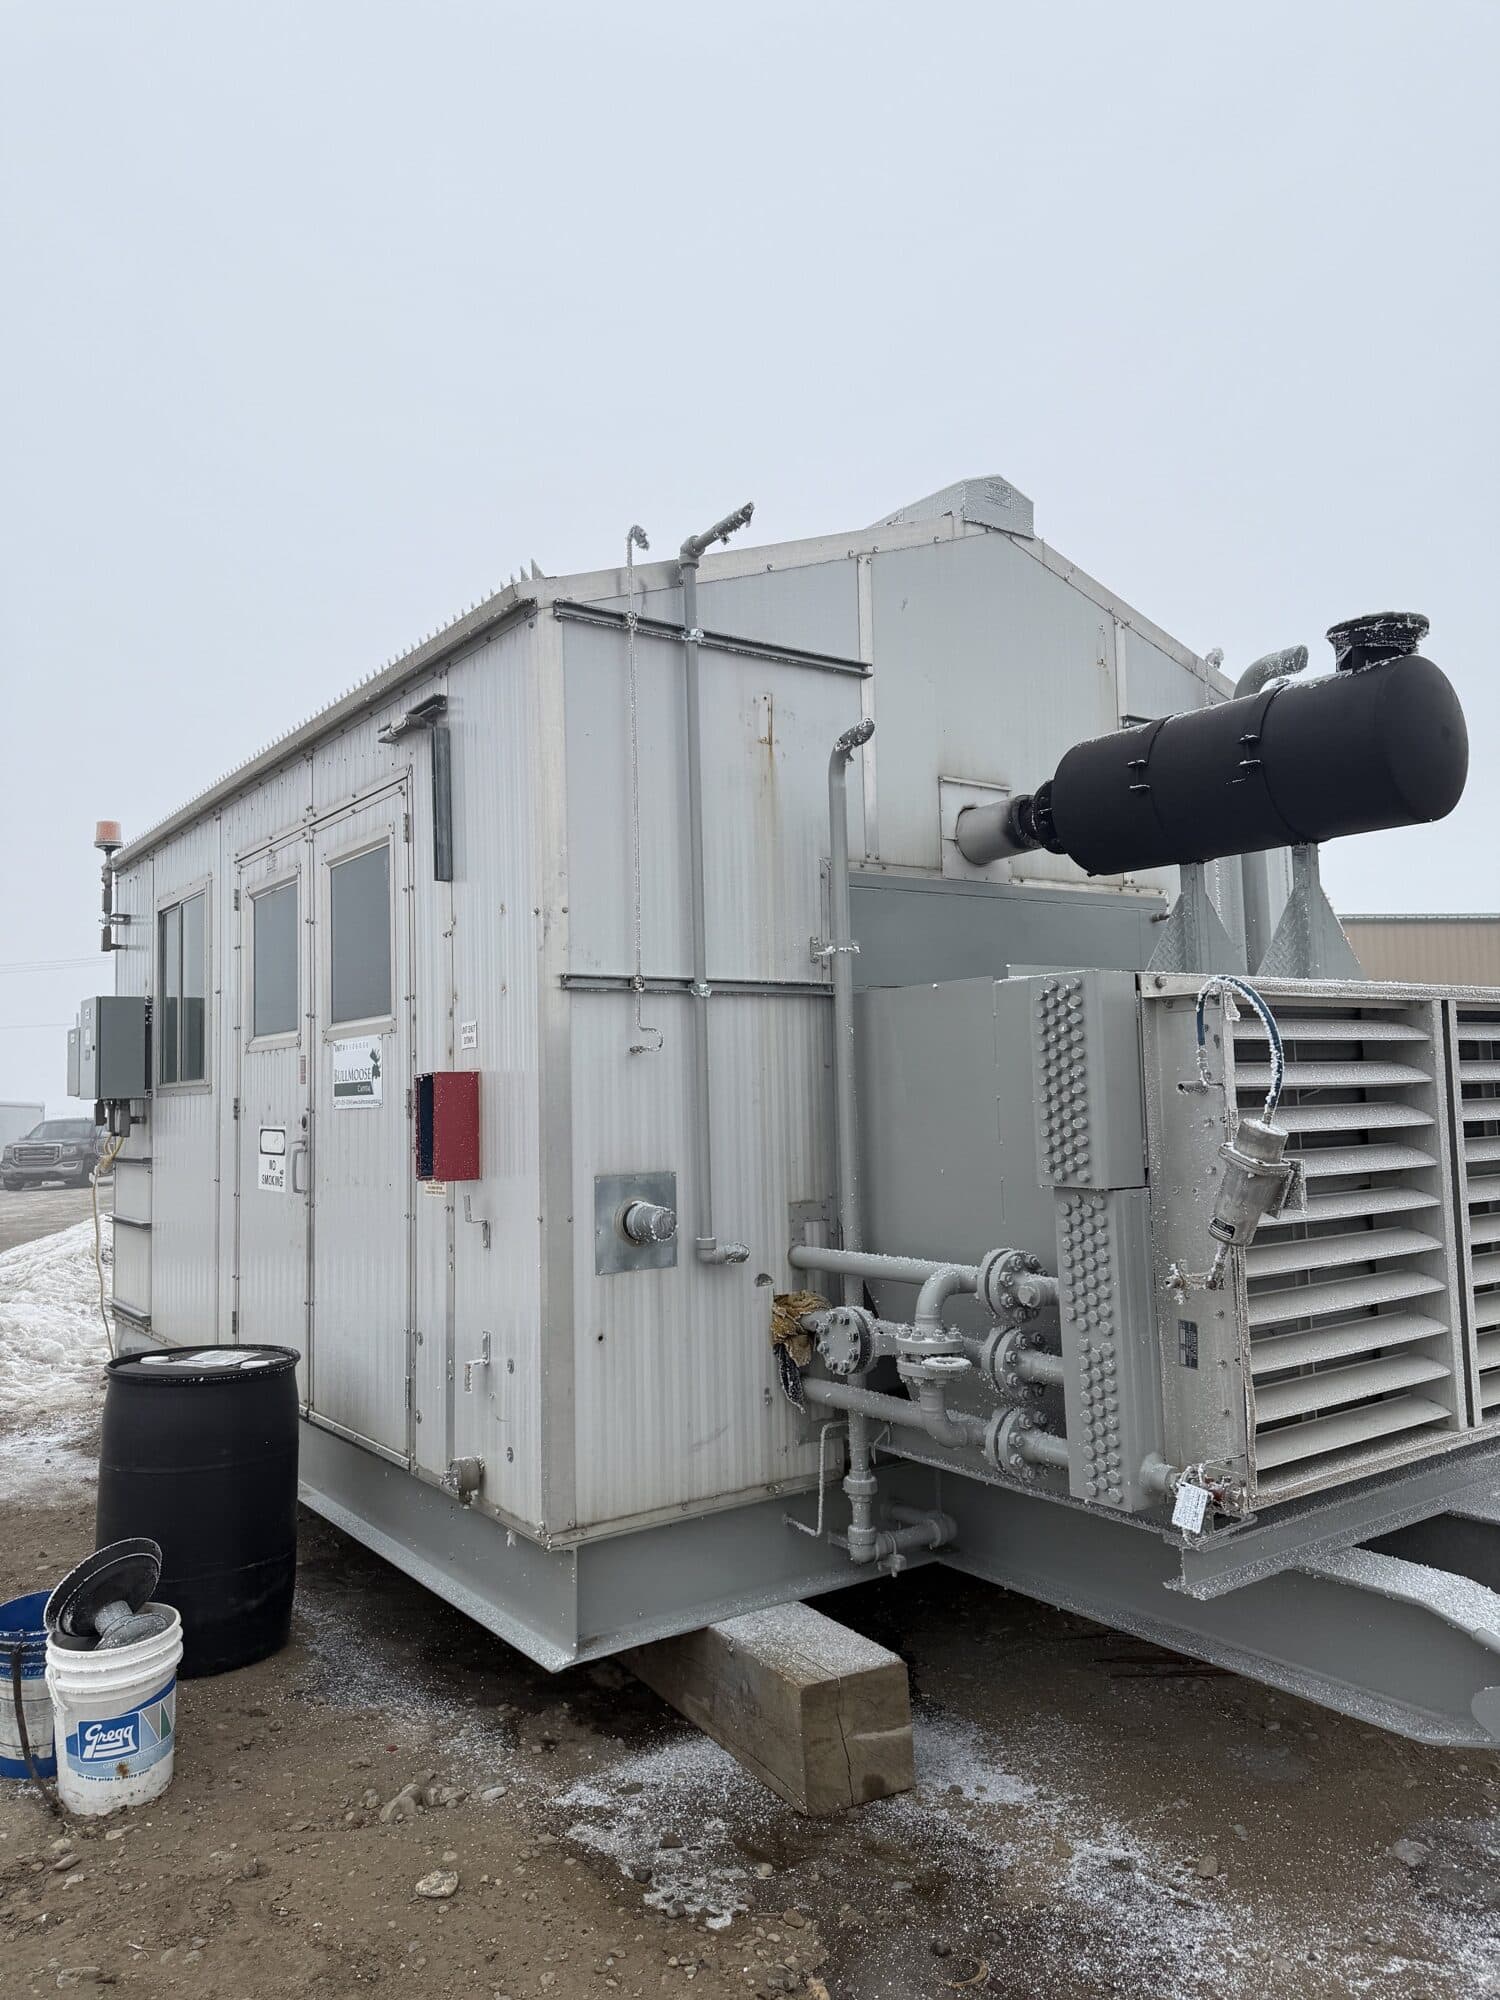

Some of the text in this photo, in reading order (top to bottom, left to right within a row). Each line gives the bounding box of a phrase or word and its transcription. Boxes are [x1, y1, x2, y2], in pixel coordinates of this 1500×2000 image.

[334, 1067, 372, 1082] BULLMOOSE
[268, 1159, 277, 1171] NO
[261, 1174, 284, 1187] SMOKING
[84, 1723, 137, 1758] Gregg
